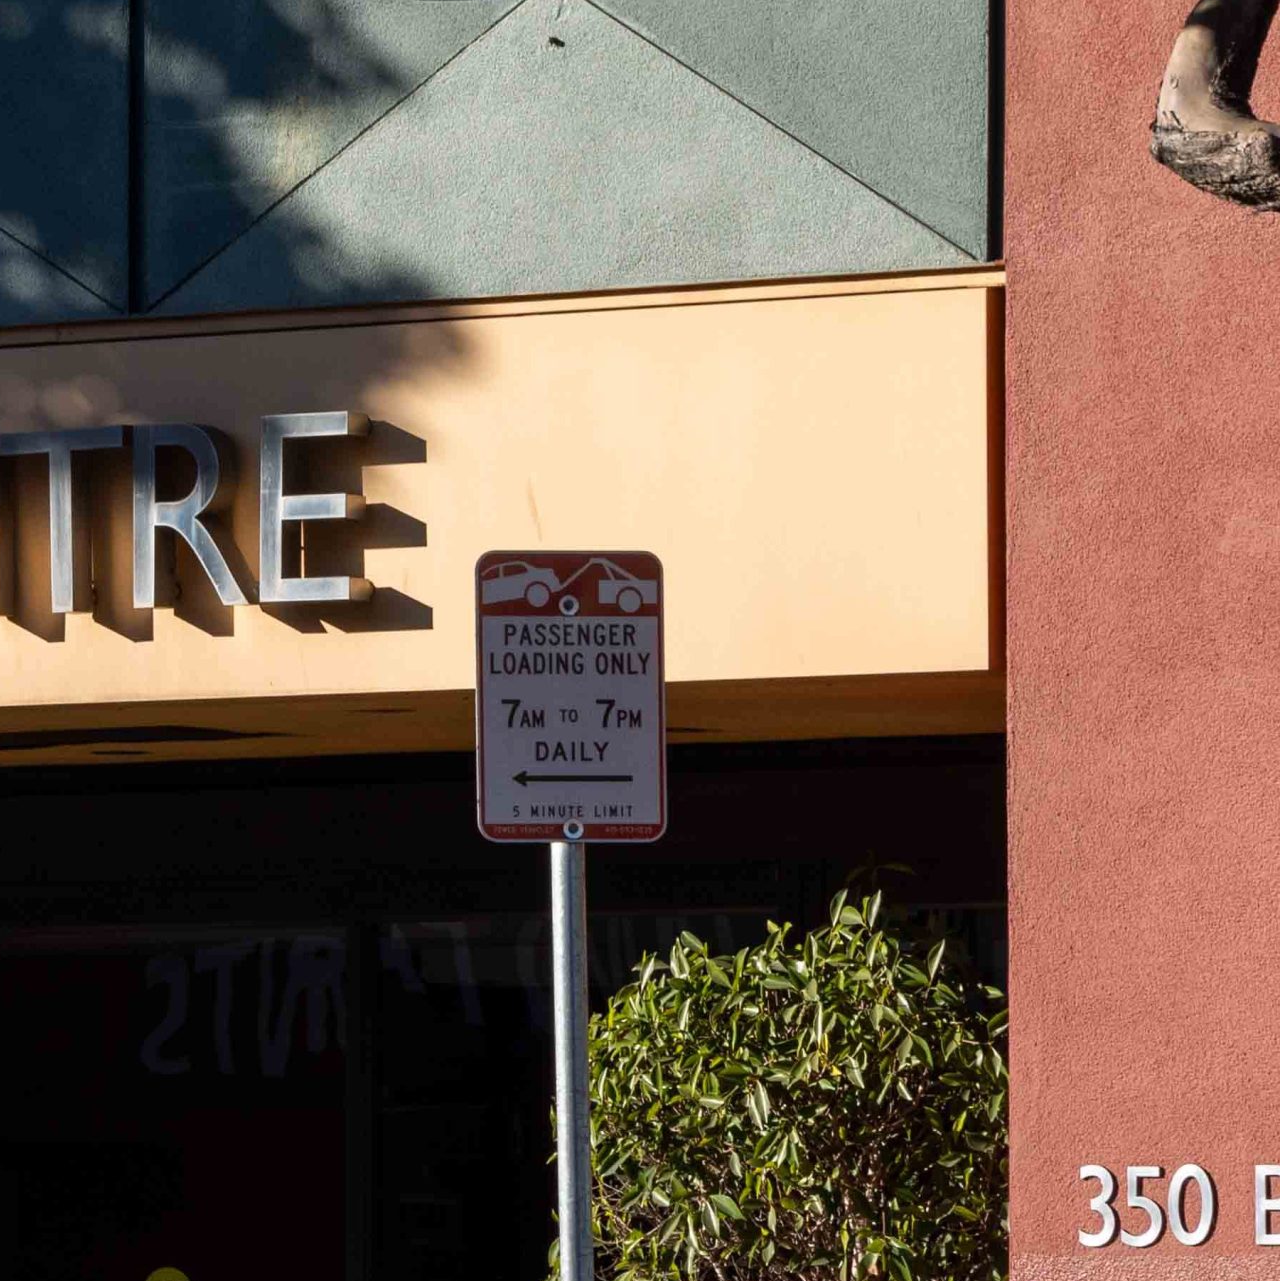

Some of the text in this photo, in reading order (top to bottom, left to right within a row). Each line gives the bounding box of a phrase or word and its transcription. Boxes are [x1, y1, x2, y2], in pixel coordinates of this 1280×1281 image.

[504, 624, 636, 646] PASSENGER
[490, 652, 651, 675] LOADING ONLY
[501, 699, 642, 728] 7AM TO 7PM
[535, 741, 609, 762] DAILY
[512, 805, 633, 818] 5 MINUTE LIMIT
[1078, 1163, 1214, 1248] 350
